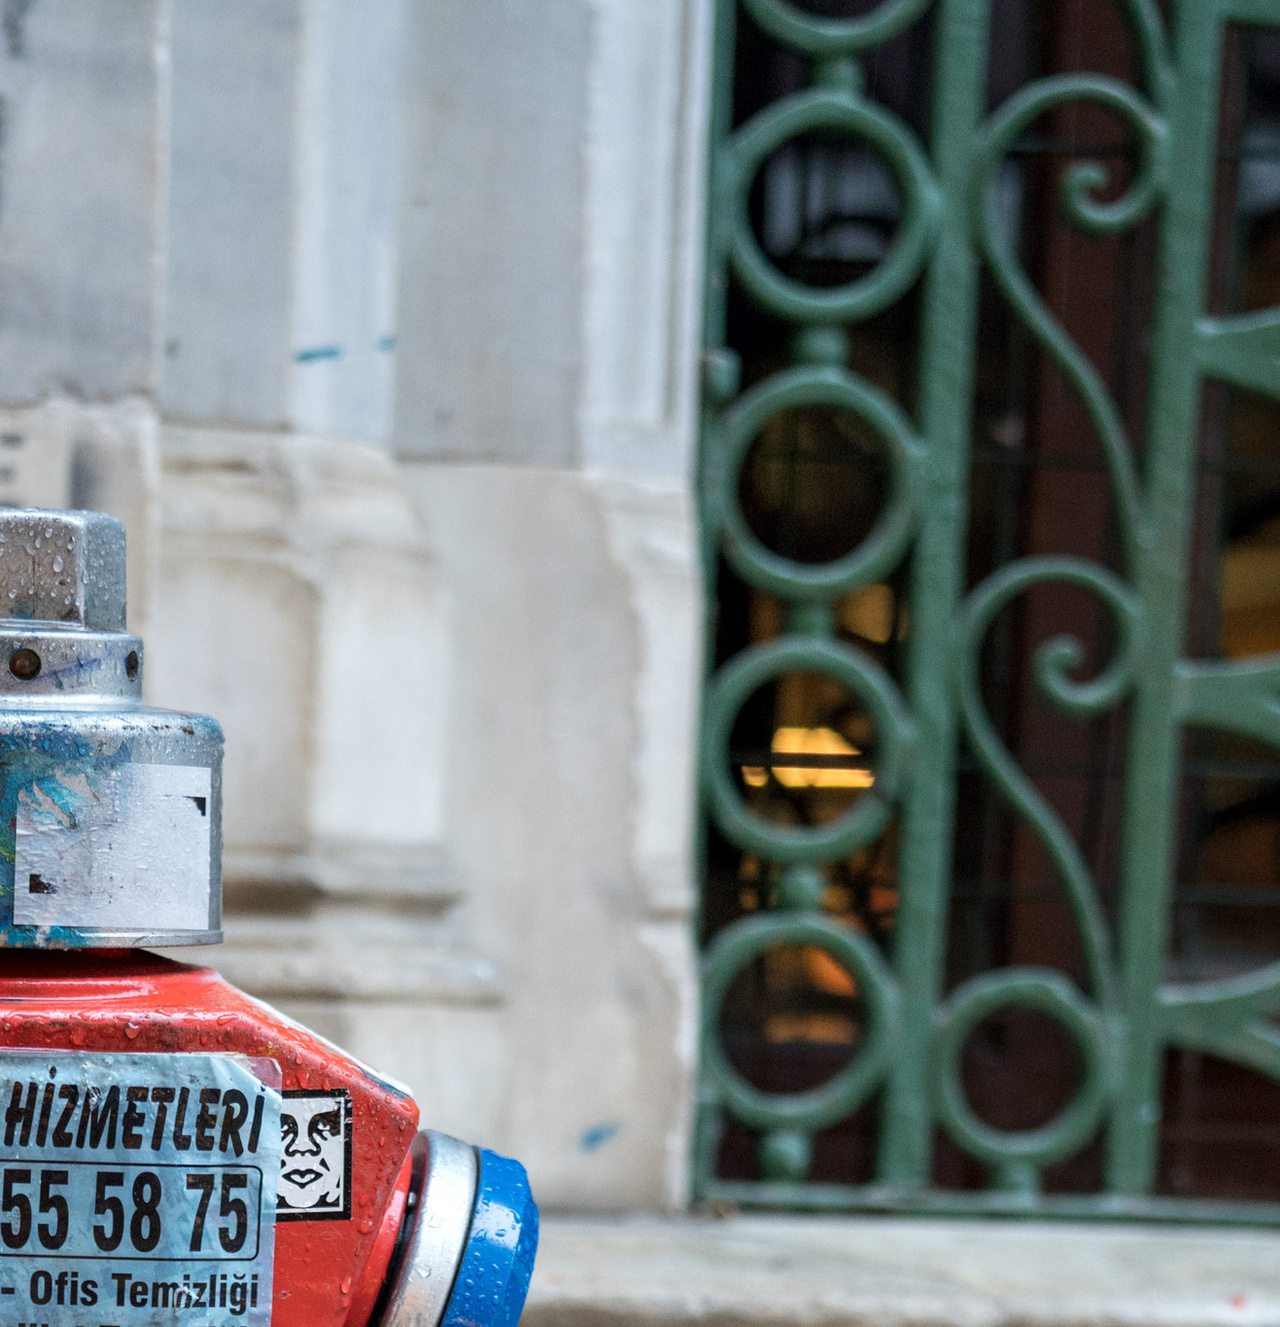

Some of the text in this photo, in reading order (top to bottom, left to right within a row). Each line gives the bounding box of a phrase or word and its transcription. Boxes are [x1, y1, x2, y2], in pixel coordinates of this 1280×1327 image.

[4, 1066, 266, 1158] HİZMETLERİ
[92, 1171, 162, 1252] 58
[185, 1173, 248, 1253] 75
[30, 1269, 98, 1307] Ofis
[111, 1272, 259, 1316] Temizliği
